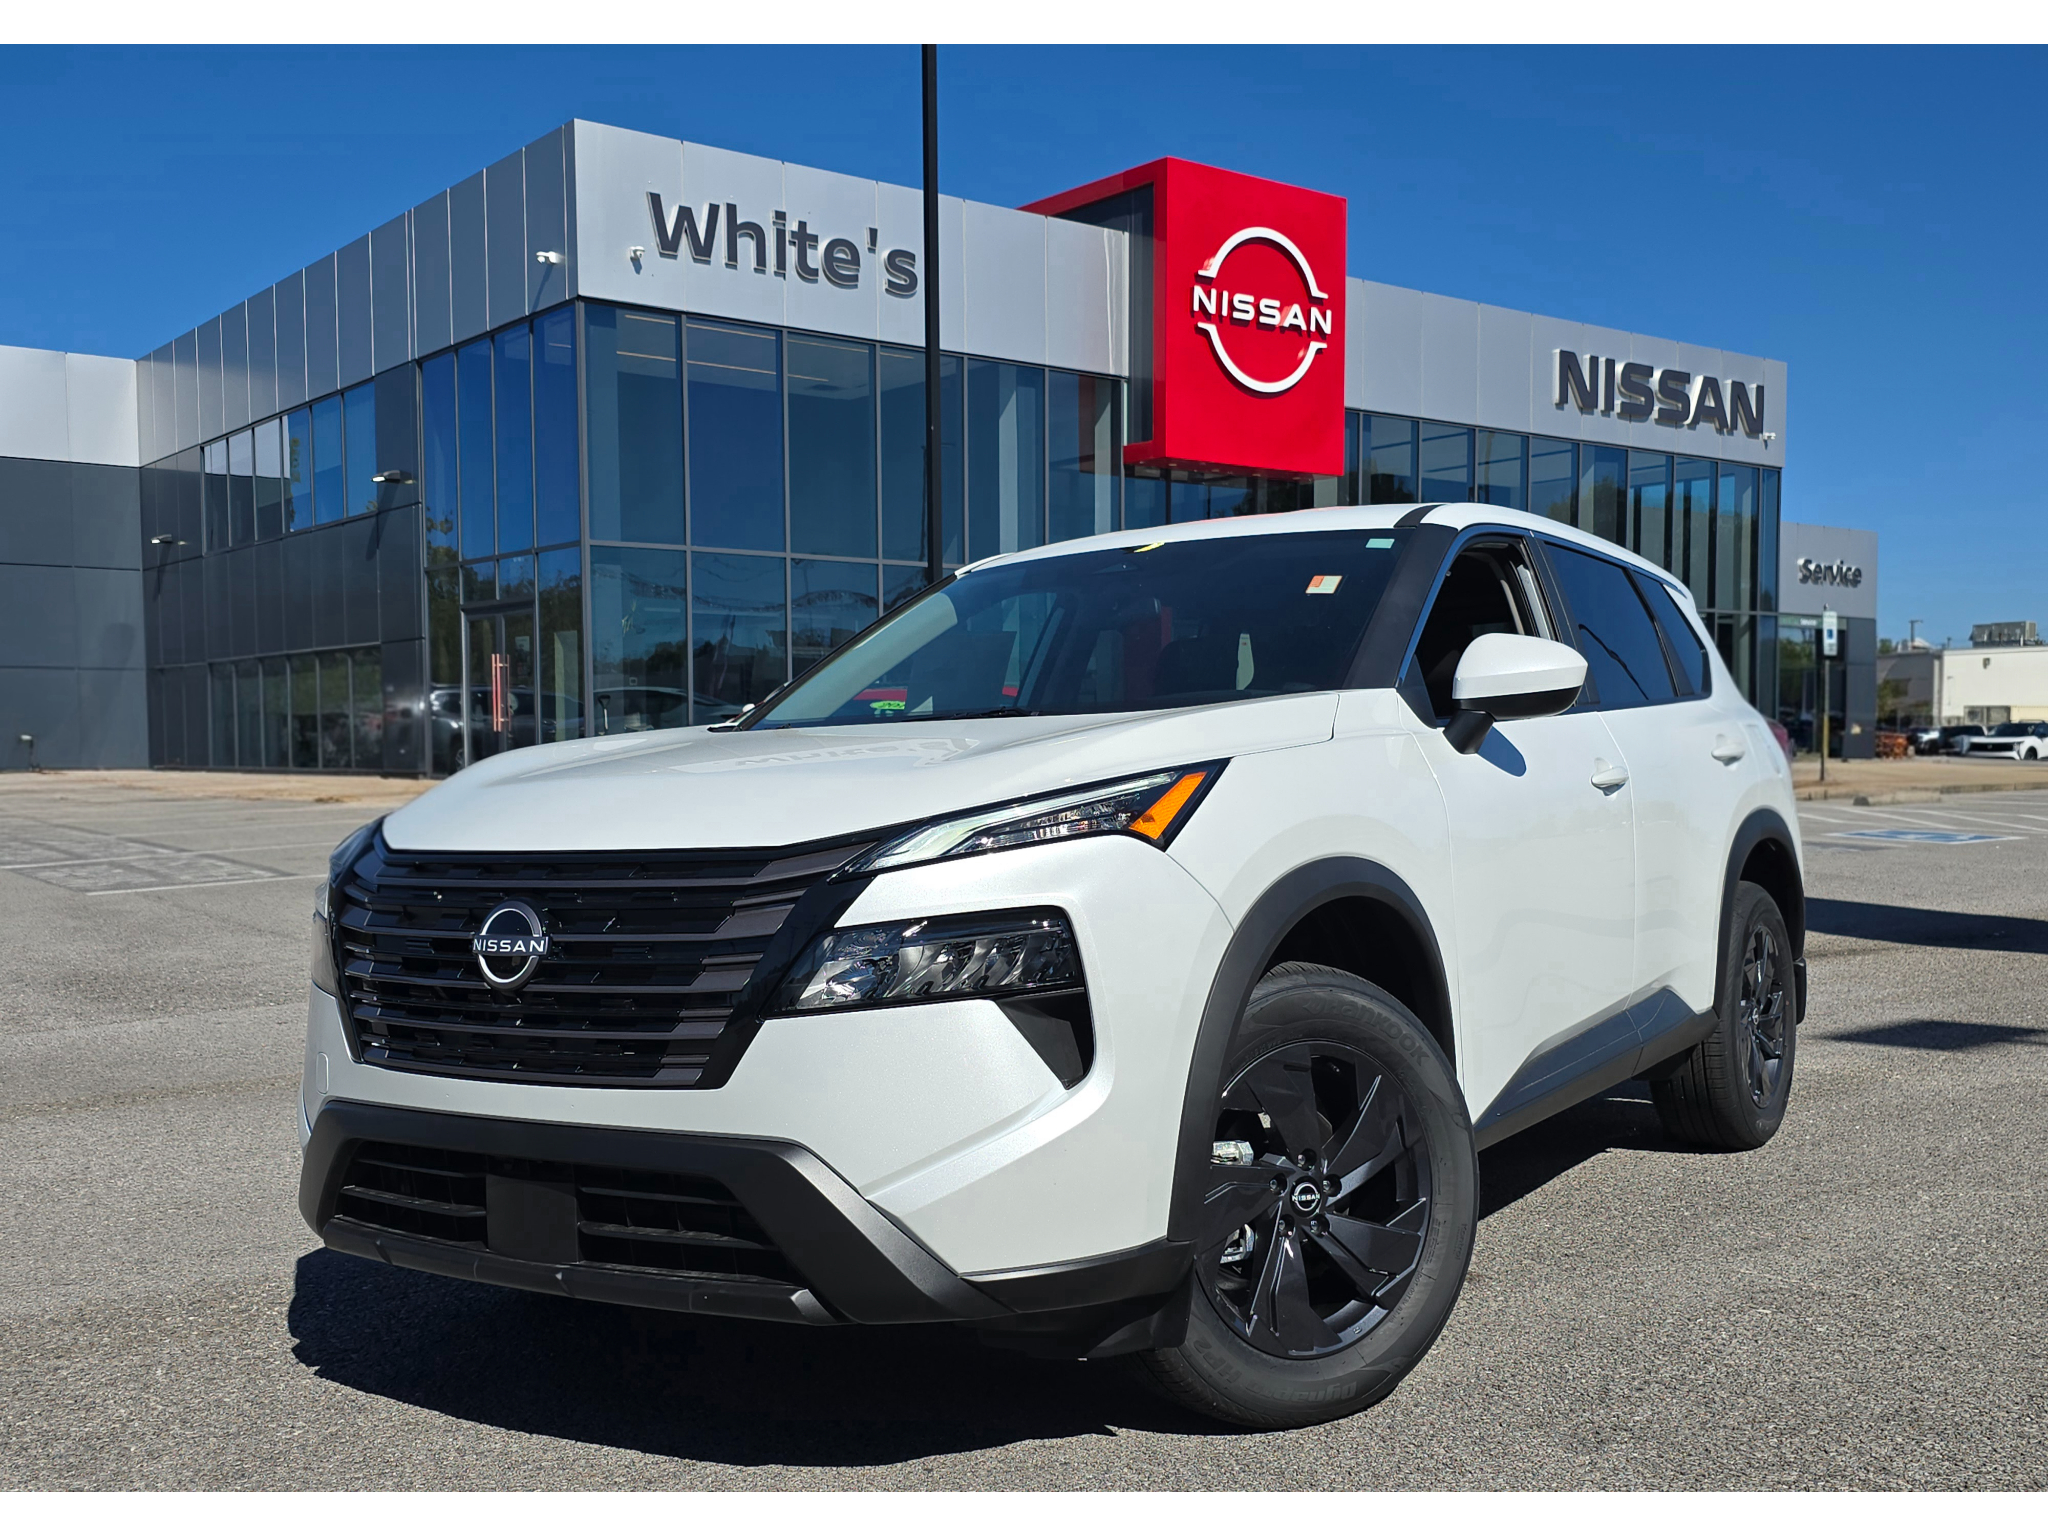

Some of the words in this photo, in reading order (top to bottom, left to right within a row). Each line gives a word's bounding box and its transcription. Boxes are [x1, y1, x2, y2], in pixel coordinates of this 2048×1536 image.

[646, 191, 918, 297] White's
[1192, 284, 1332, 335] NISSAN
[1553, 348, 1765, 436] NISSAN
[1799, 558, 1862, 587] Service
[472, 938, 545, 953] NISSAN
[1291, 1193, 1321, 1202] NISSAN
